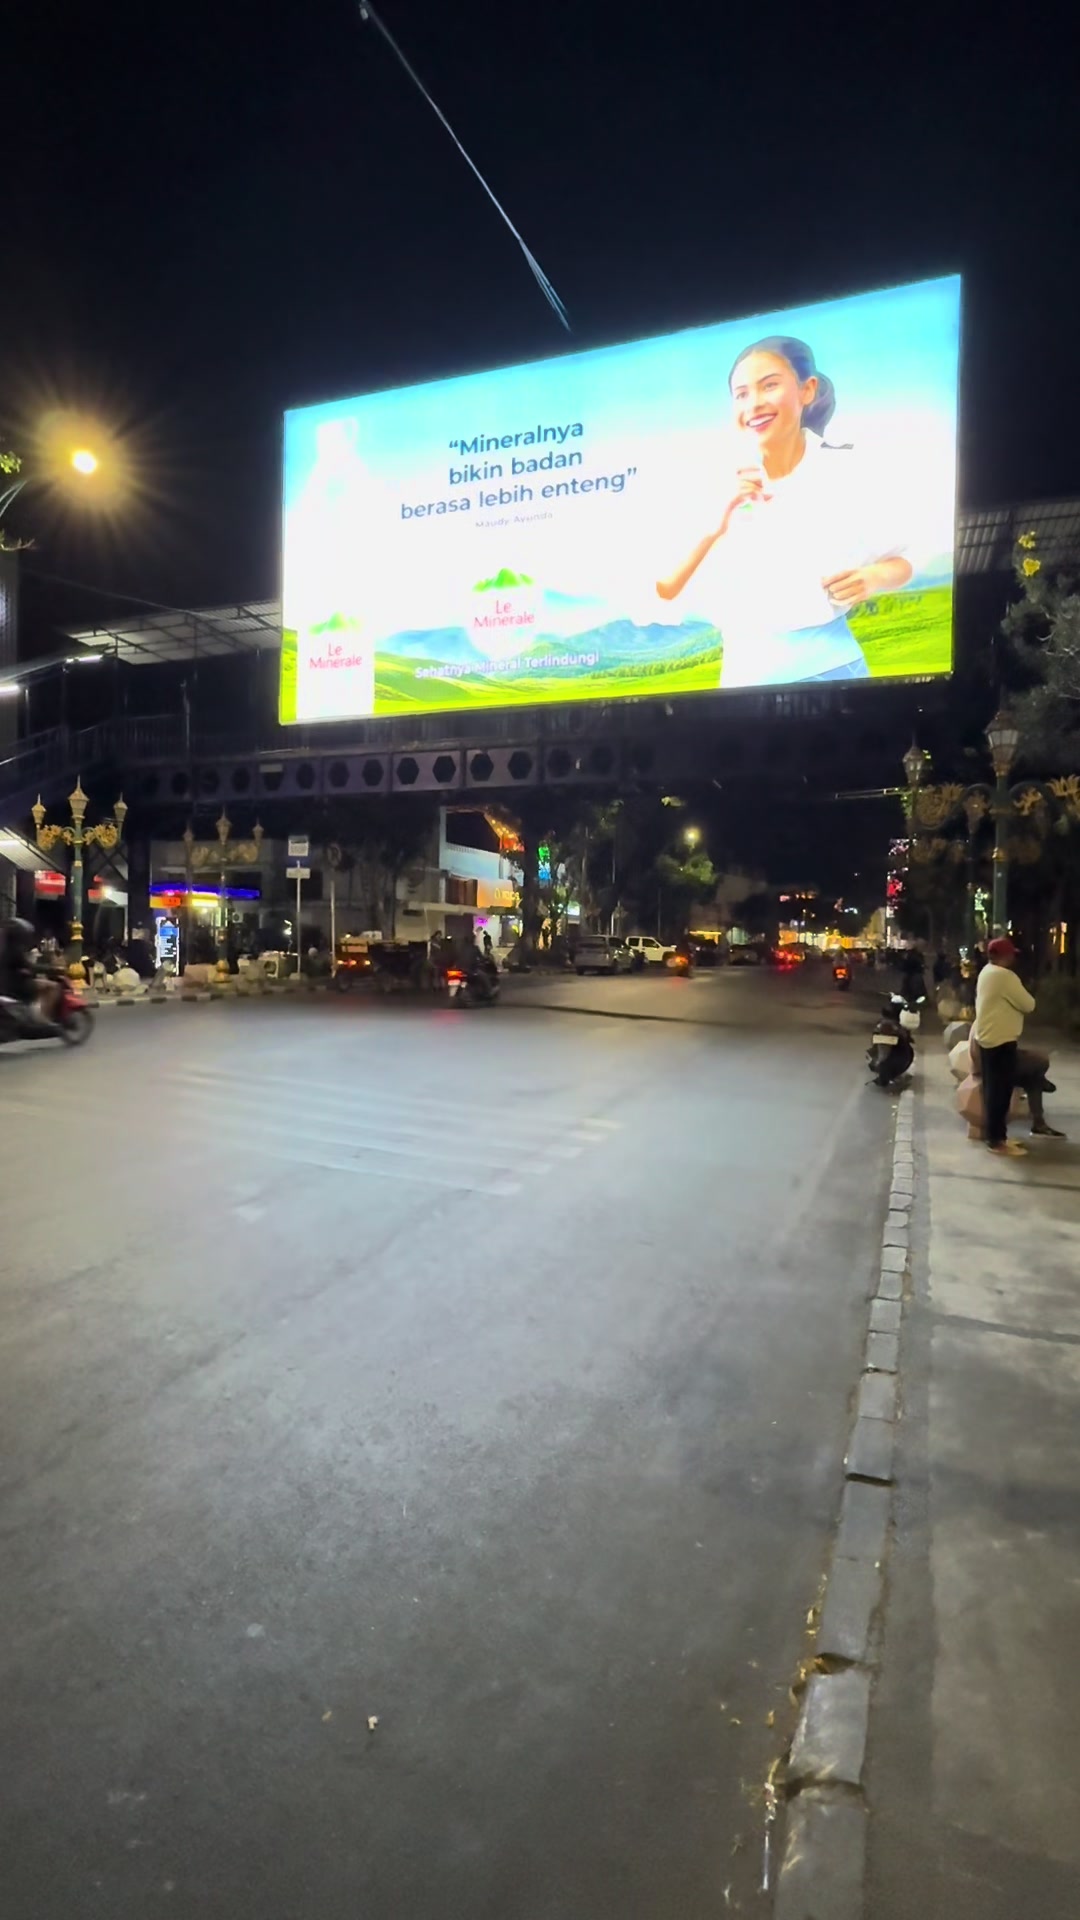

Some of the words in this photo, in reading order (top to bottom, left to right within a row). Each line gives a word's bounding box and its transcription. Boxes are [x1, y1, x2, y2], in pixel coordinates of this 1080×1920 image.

[449, 422, 584, 456] “Mineralnya
[449, 461, 503, 485] bikin
[511, 451, 583, 475] badan
[401, 496, 471, 520] berasa
[479, 484, 533, 507] lebih
[475, 517, 509, 528] Maudy
[514, 511, 553, 523] Ayunda
[495, 600, 512, 614] Le
[473, 611, 535, 628] Minerale
[328, 643, 343, 657] Le
[309, 654, 362, 670] Minerale
[414, 662, 471, 679] Sehatnya
[475, 657, 521, 674] Mineral
[525, 651, 600, 669] Terlindungi
